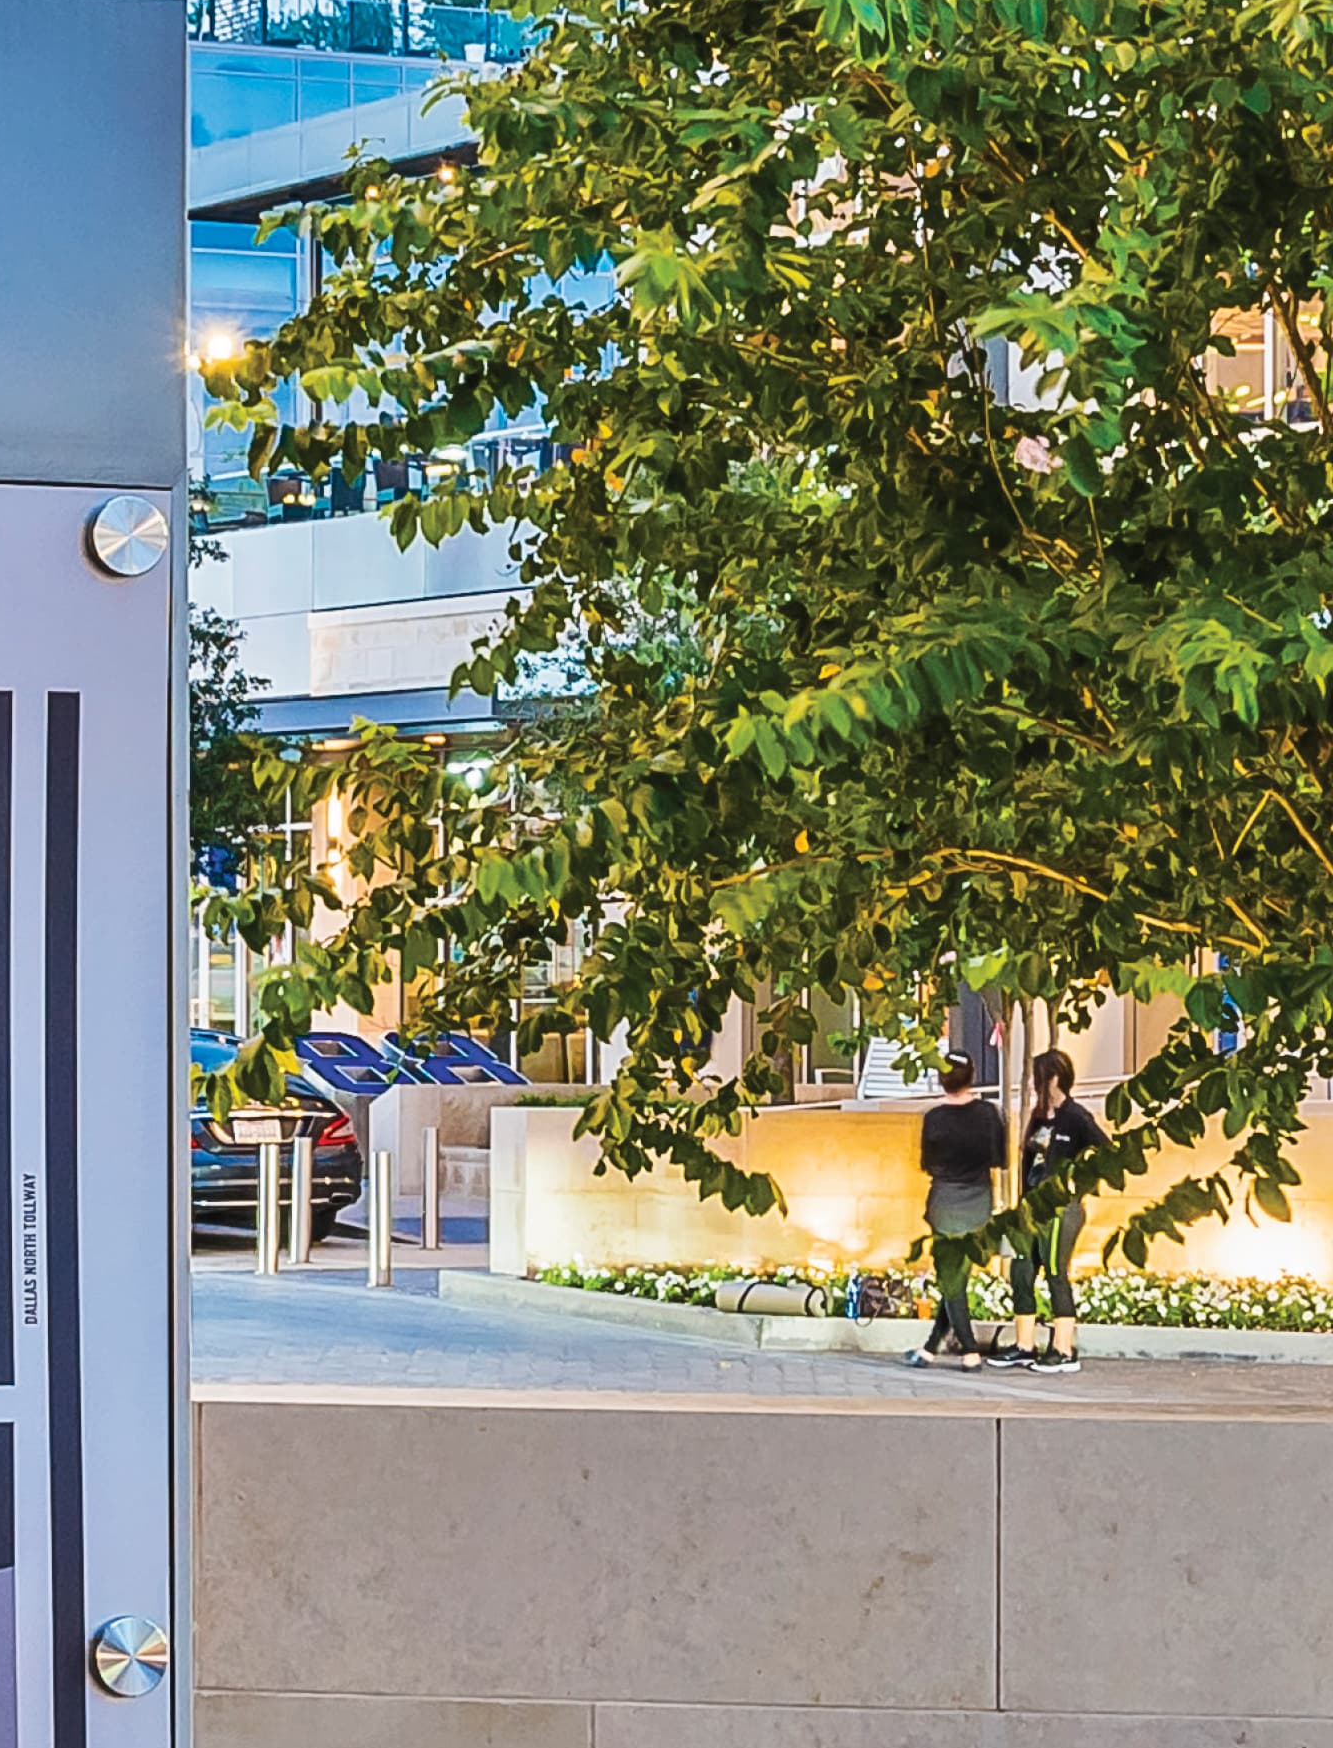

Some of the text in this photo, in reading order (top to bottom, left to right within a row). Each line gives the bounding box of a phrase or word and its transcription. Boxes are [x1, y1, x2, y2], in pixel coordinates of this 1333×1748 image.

[23, 1173, 37, 1325] DALLAS NORTH TOLLWAY
